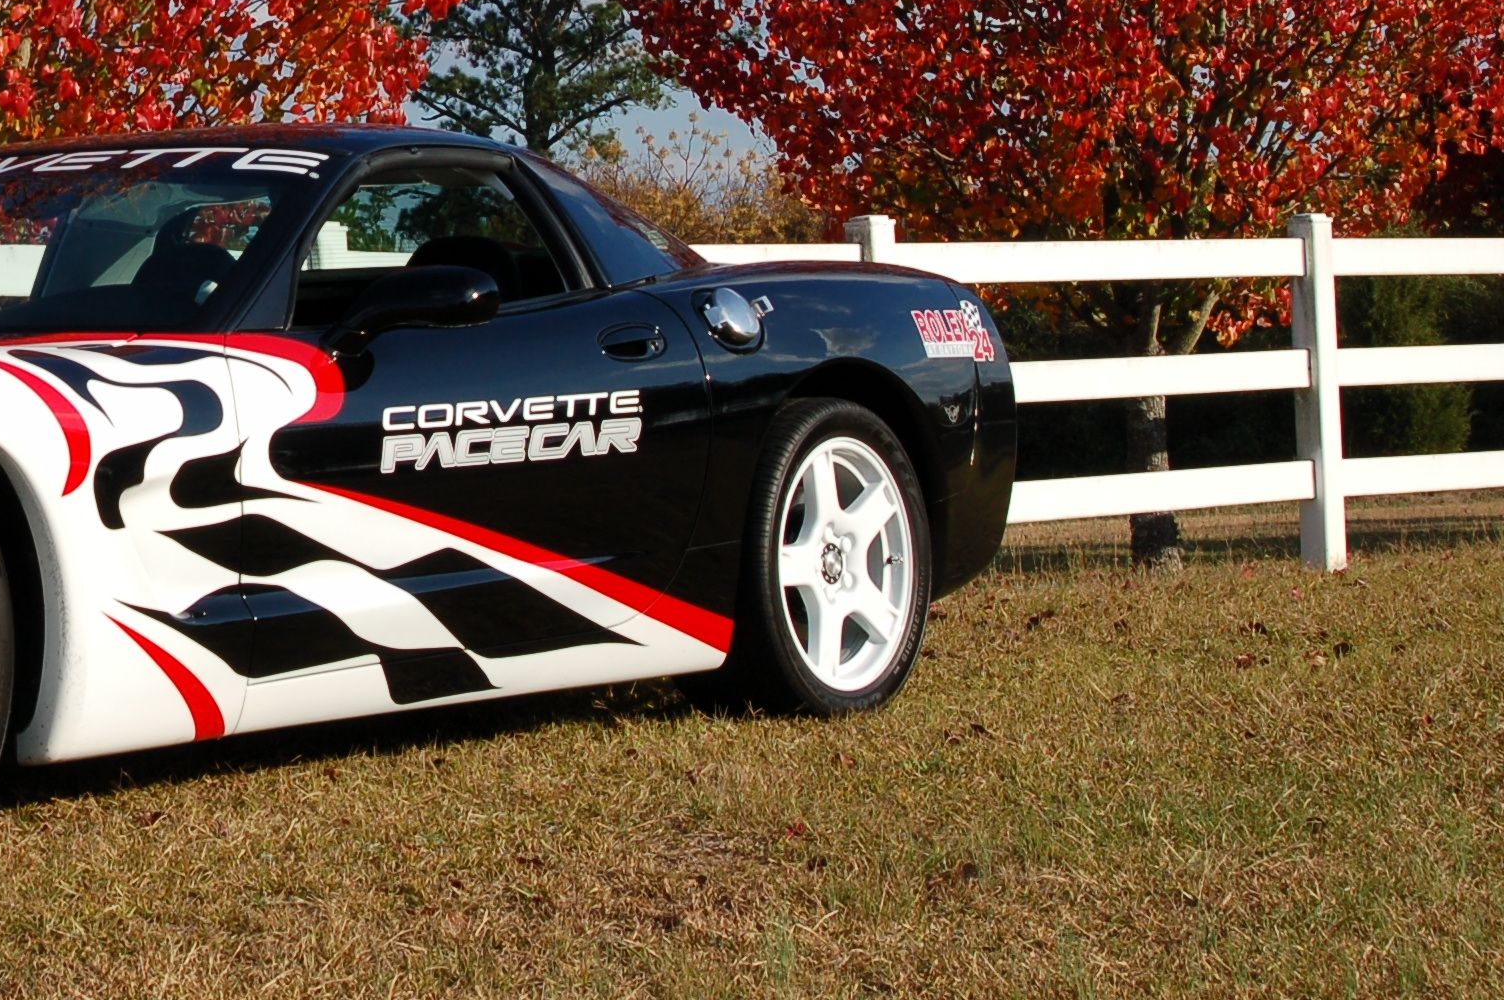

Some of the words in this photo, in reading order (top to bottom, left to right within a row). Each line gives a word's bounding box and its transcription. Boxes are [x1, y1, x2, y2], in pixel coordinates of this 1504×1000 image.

[911, 309, 973, 343] ROLEX
[968, 328, 995, 361] 24
[382, 390, 640, 430] CORVETTE
[380, 417, 642, 474] PACECAR
